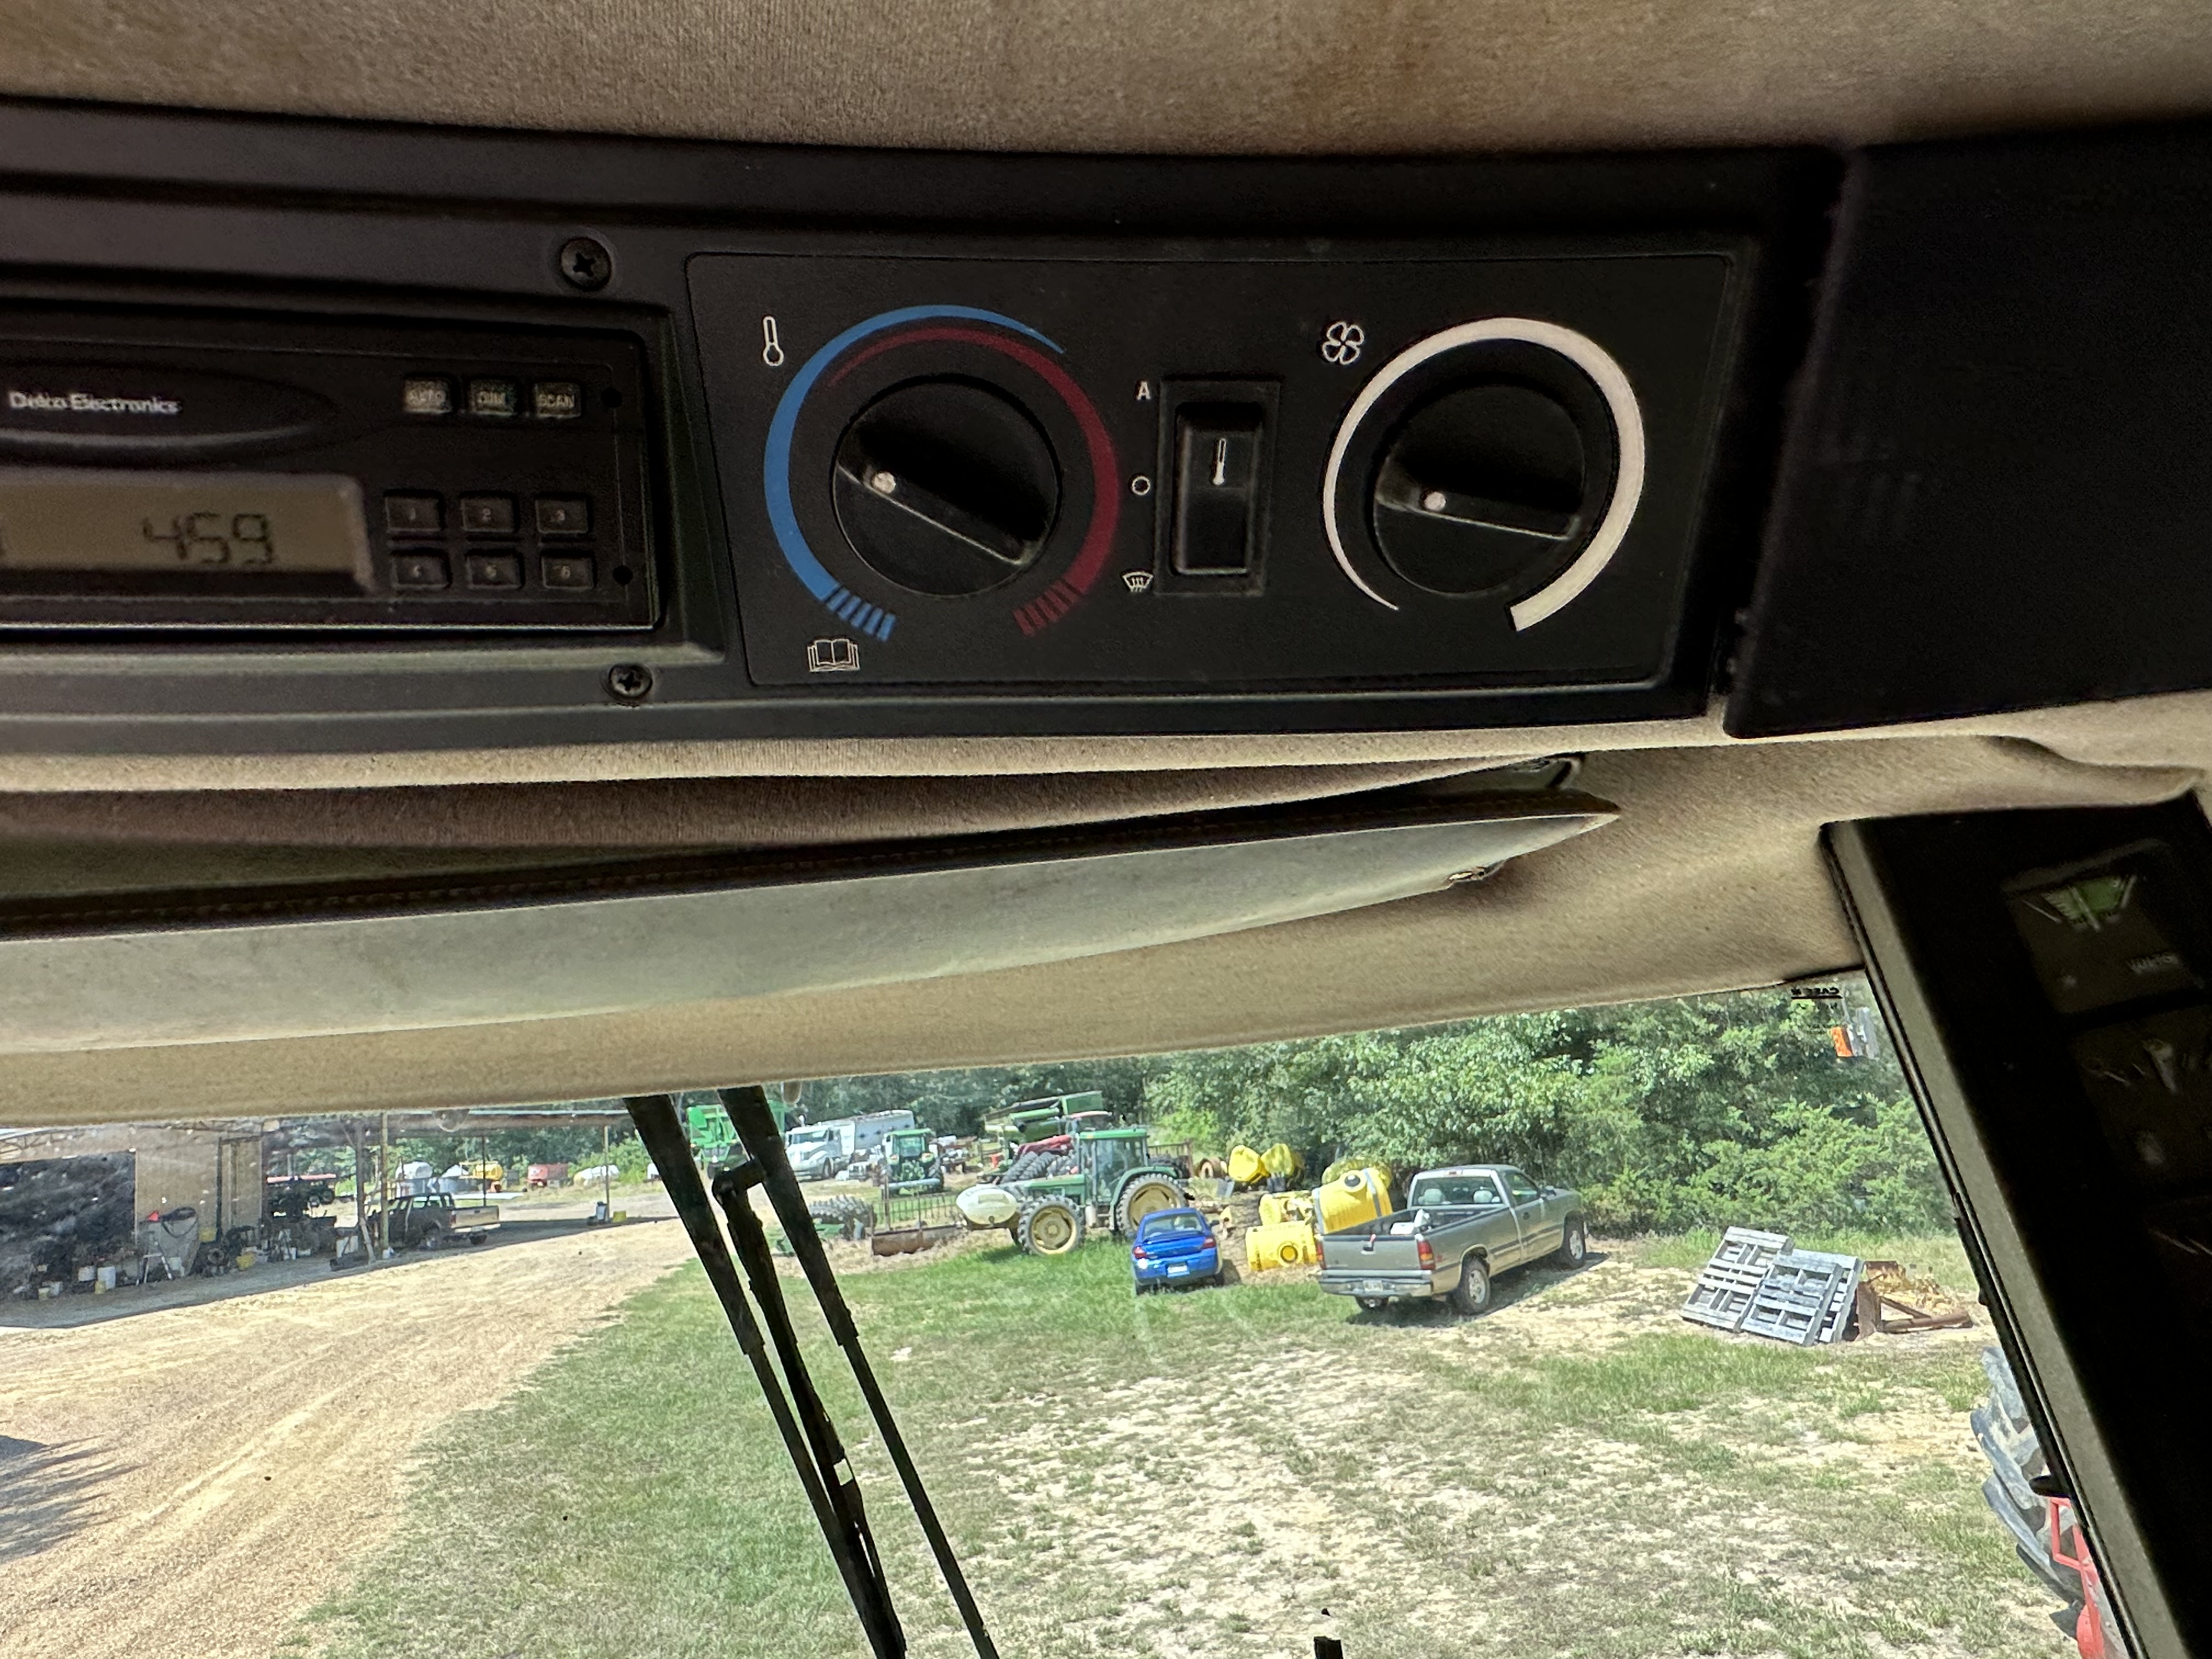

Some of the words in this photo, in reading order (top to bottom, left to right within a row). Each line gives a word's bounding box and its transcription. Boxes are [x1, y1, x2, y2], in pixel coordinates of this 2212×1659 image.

[538, 393, 575, 408] SCAN
[1137, 381, 1151, 400] A
[8, 391, 68, 409] Delco
[69, 392, 182, 414] Electronics
[143, 512, 274, 565] 459
